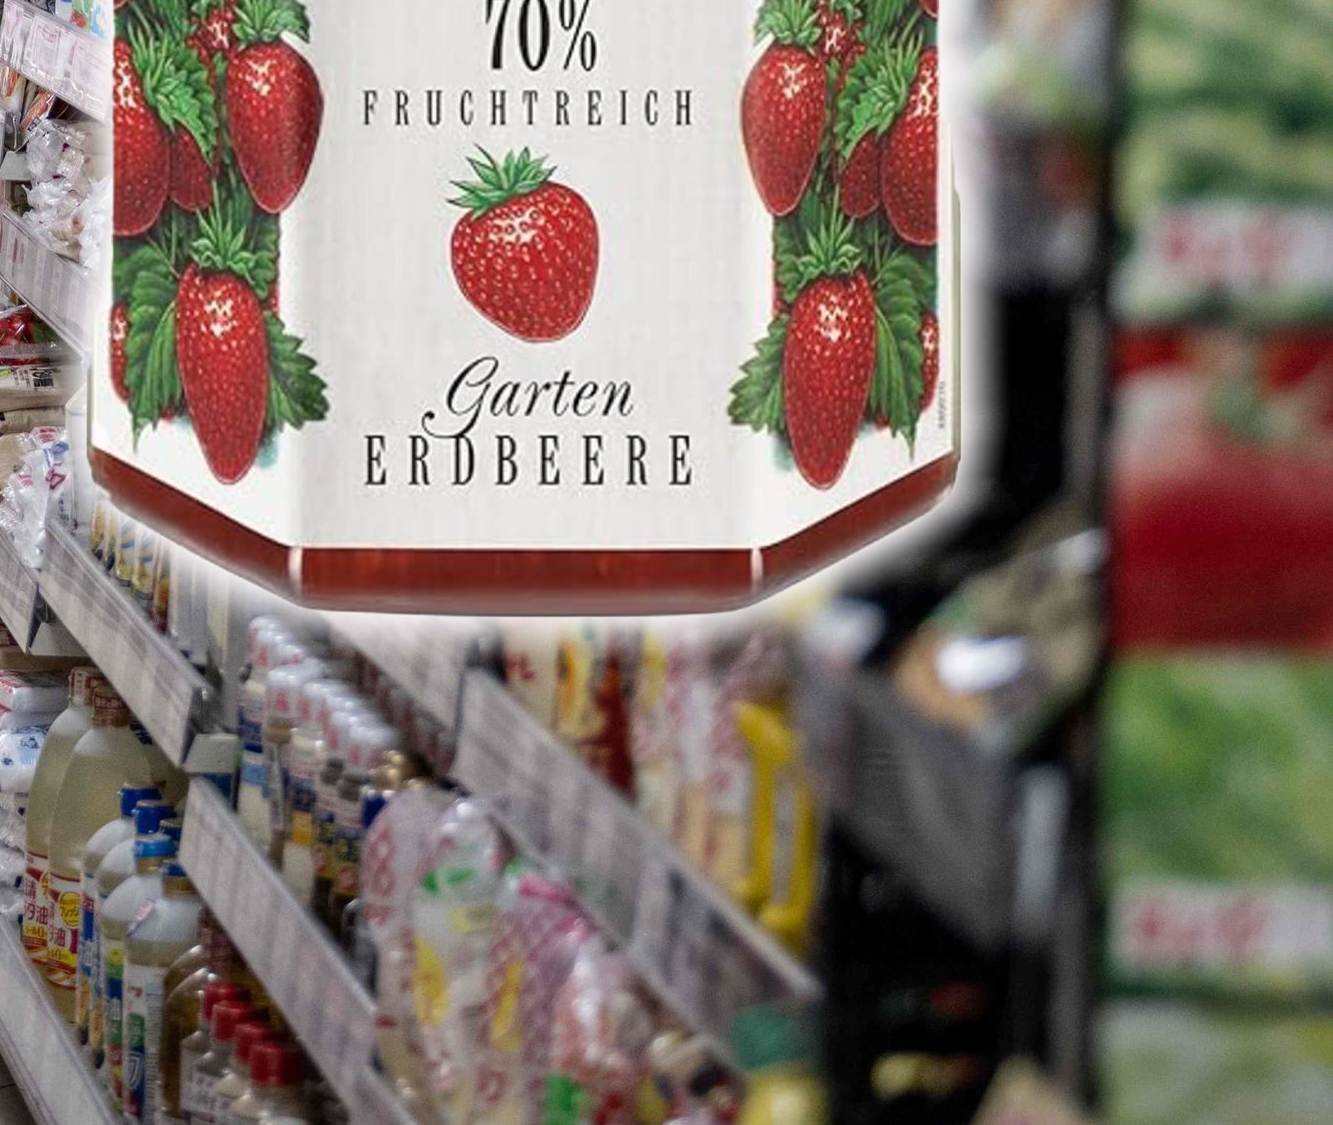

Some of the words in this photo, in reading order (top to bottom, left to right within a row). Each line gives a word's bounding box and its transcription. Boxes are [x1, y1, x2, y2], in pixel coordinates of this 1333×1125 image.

[360, 88, 697, 127] FRUCHTREICH
[422, 355, 634, 440] Garten
[364, 433, 696, 488] ERDBEERE
